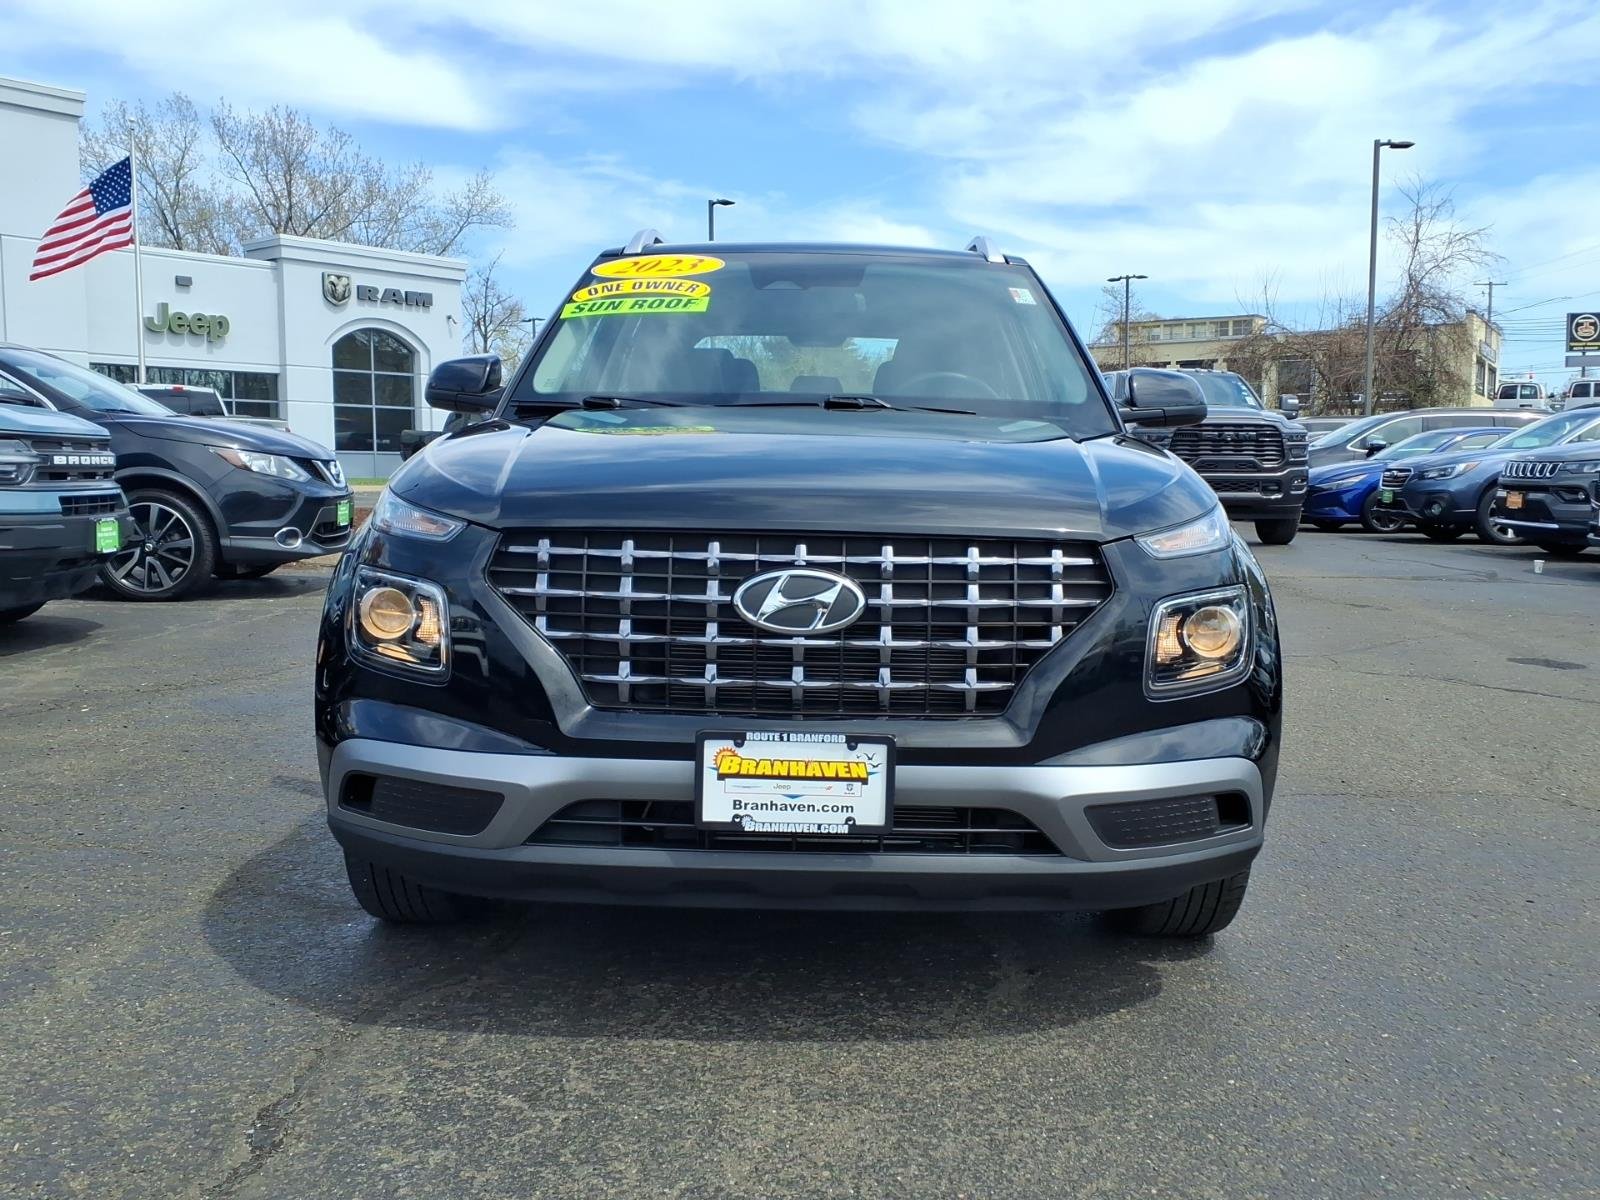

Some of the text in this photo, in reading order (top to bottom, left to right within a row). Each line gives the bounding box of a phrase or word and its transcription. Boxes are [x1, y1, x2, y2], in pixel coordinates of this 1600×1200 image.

[613, 258, 705, 274] 2023
[356, 284, 433, 307] RAM
[587, 281, 700, 296] ONE OWNER
[571, 298, 700, 314] SUN ROOF
[144, 302, 230, 342] Jeep
[53, 455, 115, 465] BRONCO
[746, 732, 846, 743] ROUTE 1 BRANFORD
[717, 754, 869, 781] BRANHAVEN
[773, 783, 792, 791] Jeep
[732, 799, 854, 814] Branhaven.com
[744, 820, 849, 834] BRANHAVEN.COM
